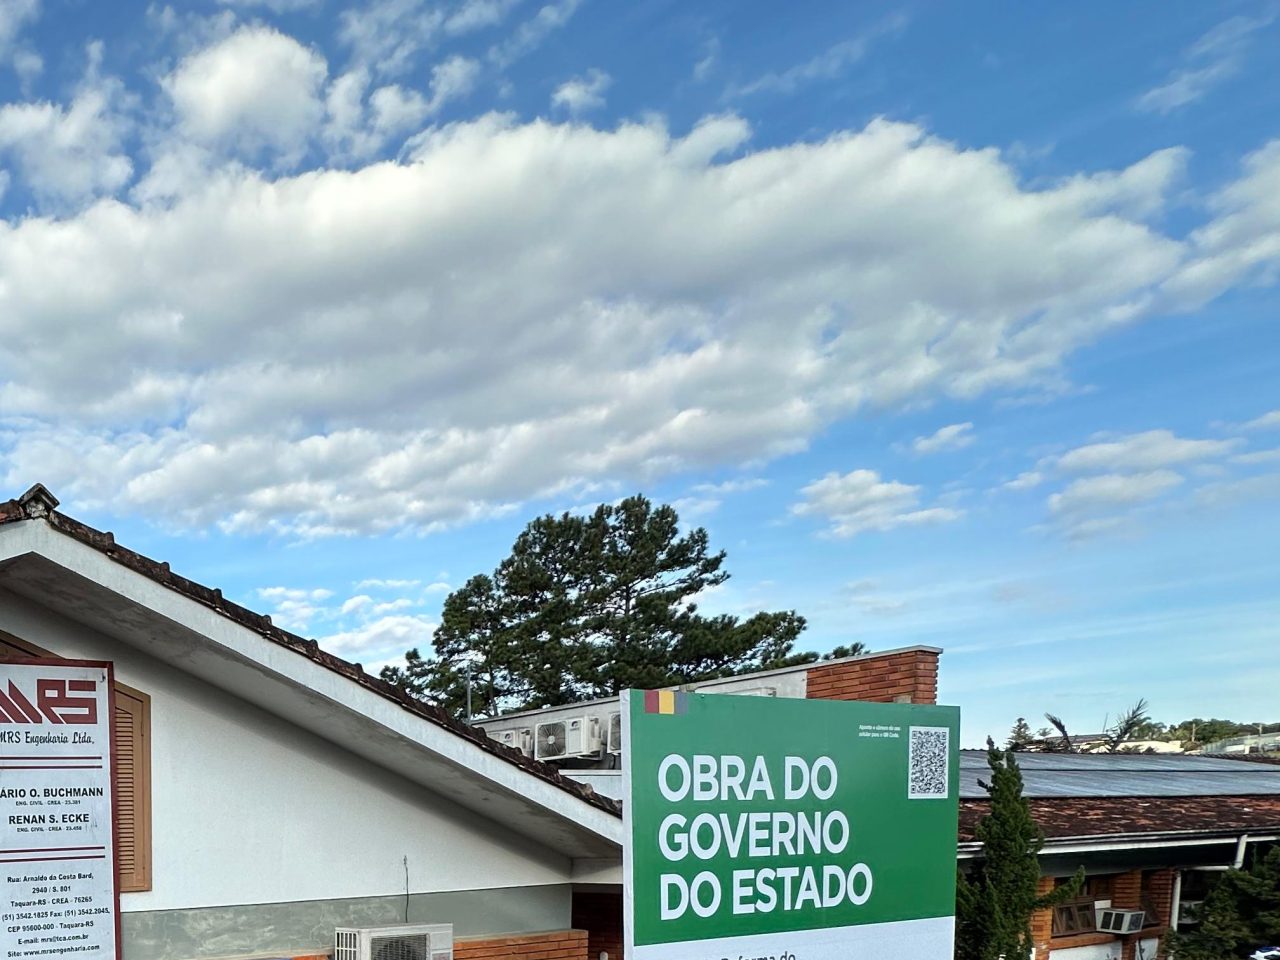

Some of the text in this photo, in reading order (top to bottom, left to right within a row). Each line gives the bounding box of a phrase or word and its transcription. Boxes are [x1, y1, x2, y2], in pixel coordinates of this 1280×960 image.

[25, 731, 69, 746] Engenharia
[72, 732, 95, 744] Ltda.
[658, 753, 838, 802] OBRA DO
[30, 788, 40, 797] O.
[44, 788, 103, 797] BUCHMANN
[8, 814, 90, 824] RENAN S. ECKE
[658, 810, 850, 862] GOVERNO
[660, 863, 873, 920] DO ESTADO
[11, 899, 46, 908] Taquara-RS
[2, 913, 14, 922] (51)
[60, 921, 94, 930] Taquara-RS
